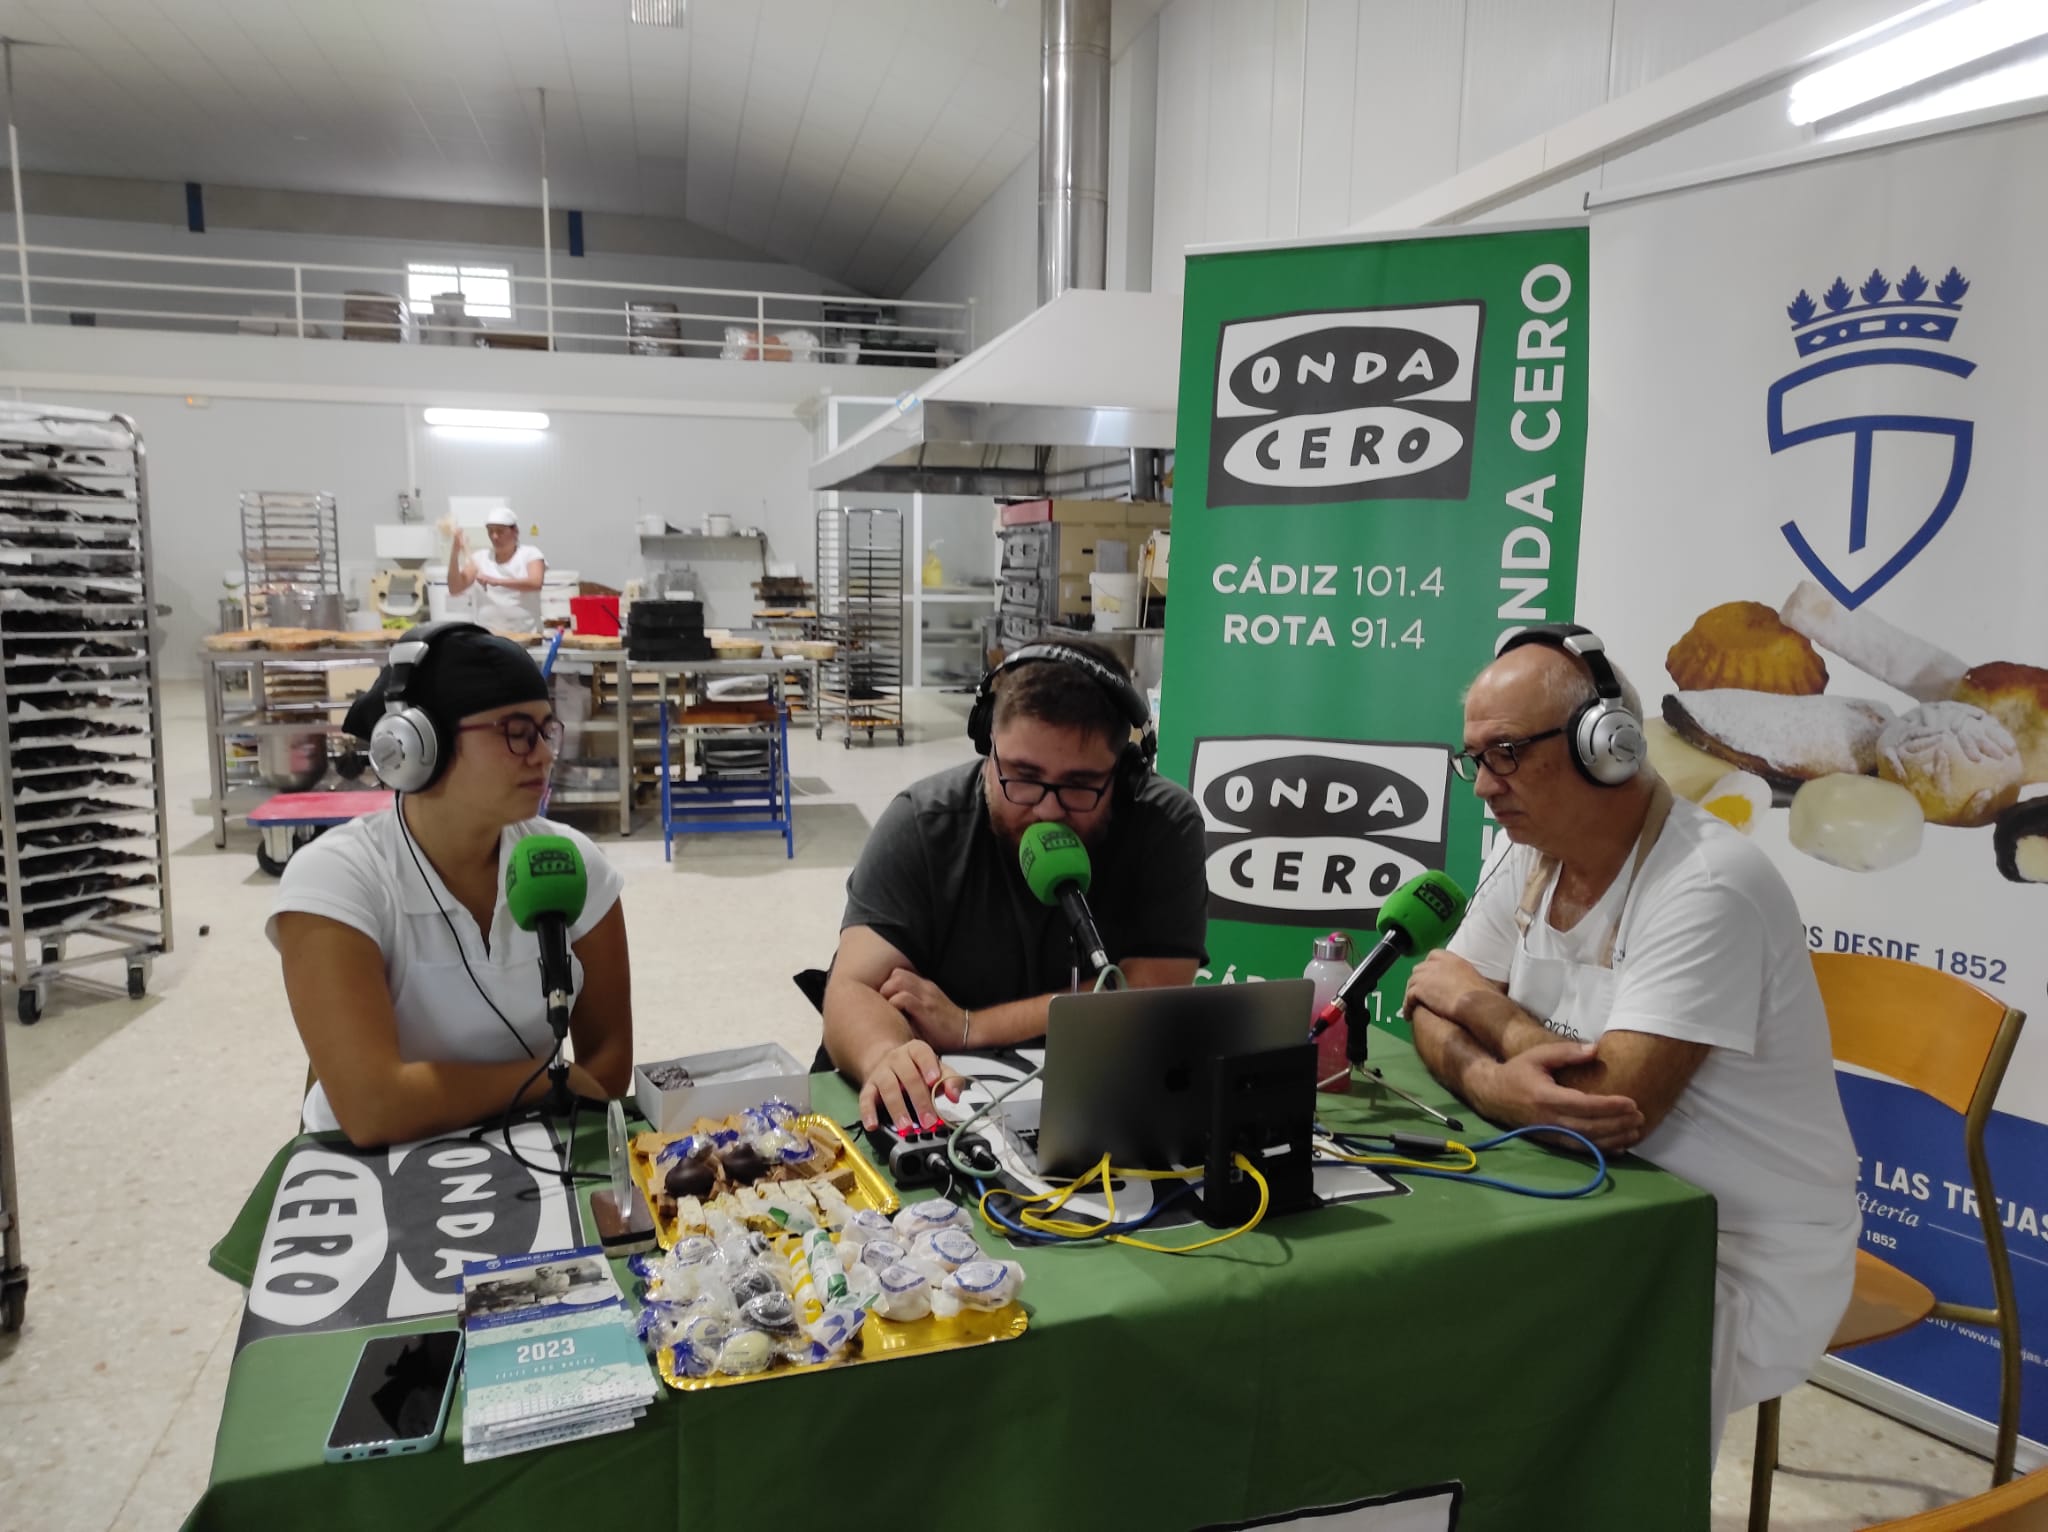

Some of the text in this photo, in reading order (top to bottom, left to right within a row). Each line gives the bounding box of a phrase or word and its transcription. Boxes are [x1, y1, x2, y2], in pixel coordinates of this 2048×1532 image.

[1251, 348, 1434, 394] ONDA
[1255, 425, 1431, 471] CERO
[1494, 263, 1572, 658] NDA CERO
[1212, 556, 1445, 598] CÁDIZ 101.4
[1224, 614, 1426, 650] ROTA 91.4
[1224, 775, 1405, 819] ONDA
[1229, 849, 1402, 896] CERO
[1833, 929, 1921, 962] DESDE
[1934, 947, 2008, 985] 1852
[1874, 1160, 1931, 1201] LAS
[265, 1169, 358, 1296] CERO
[428, 1147, 498, 1279] ONDA
[1865, 1229, 1897, 1250] 1852
[516, 1337, 576, 1364] 2023
